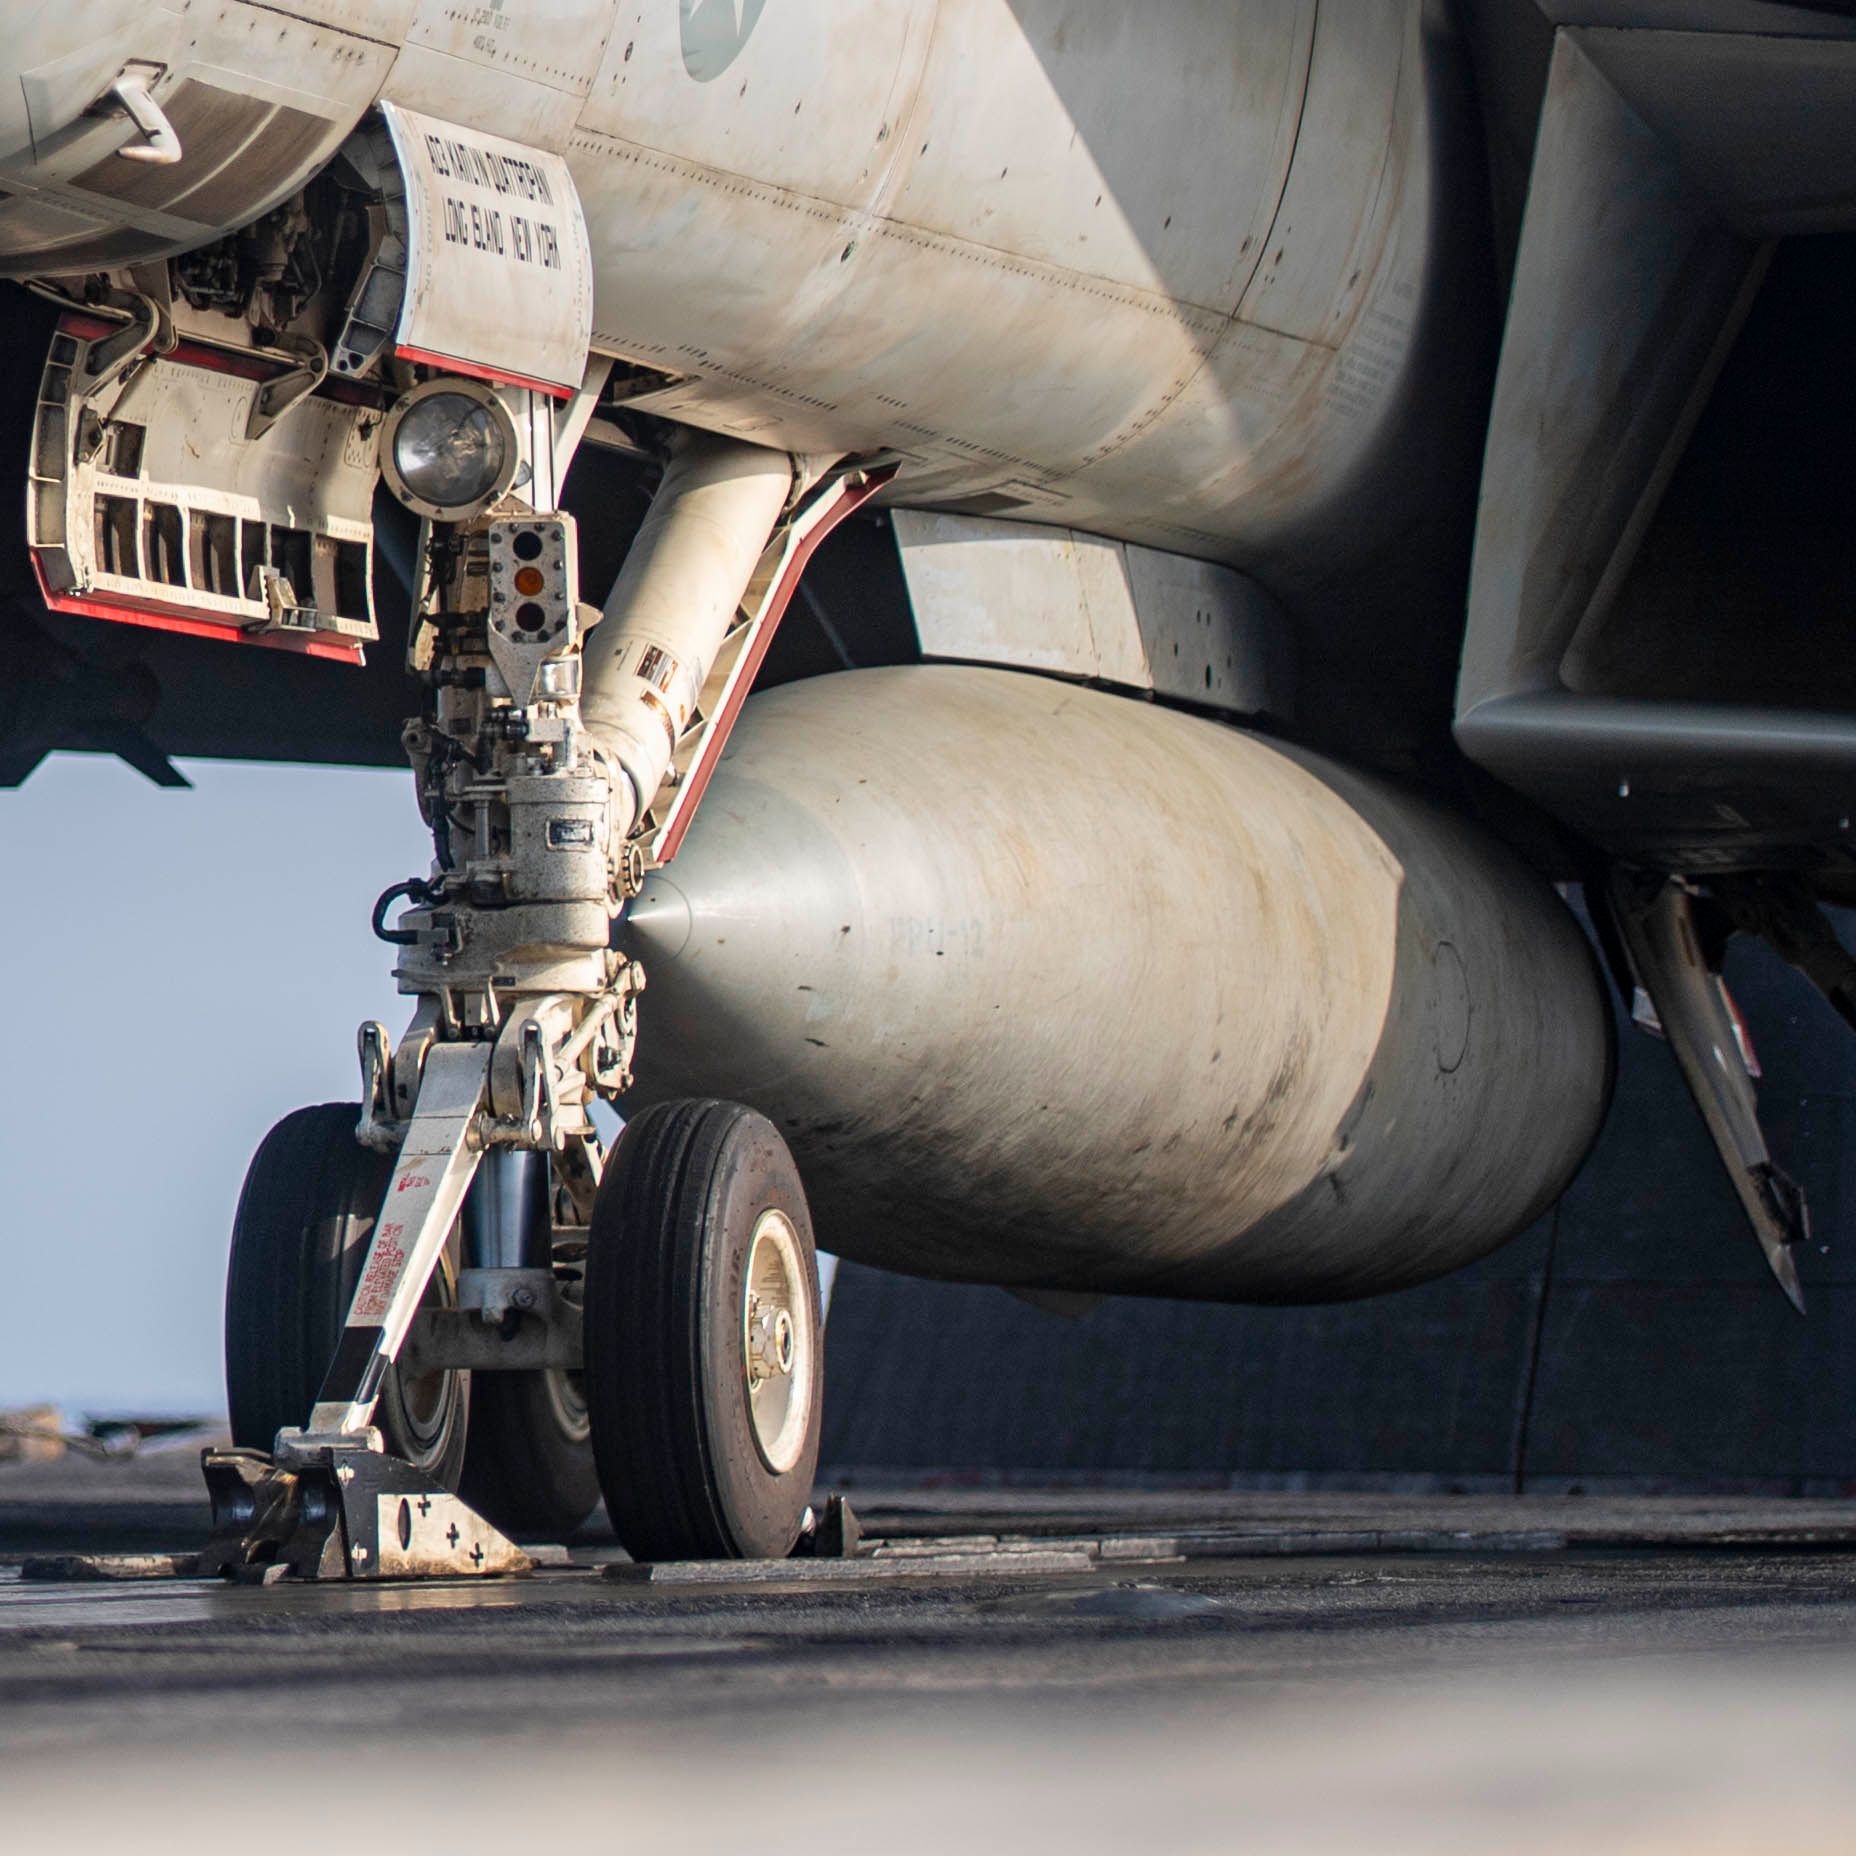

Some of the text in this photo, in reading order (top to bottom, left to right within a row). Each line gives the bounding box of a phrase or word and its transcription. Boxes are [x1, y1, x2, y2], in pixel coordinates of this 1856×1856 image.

[442, 197, 561, 270] LONG ISLAND NEW YORK
